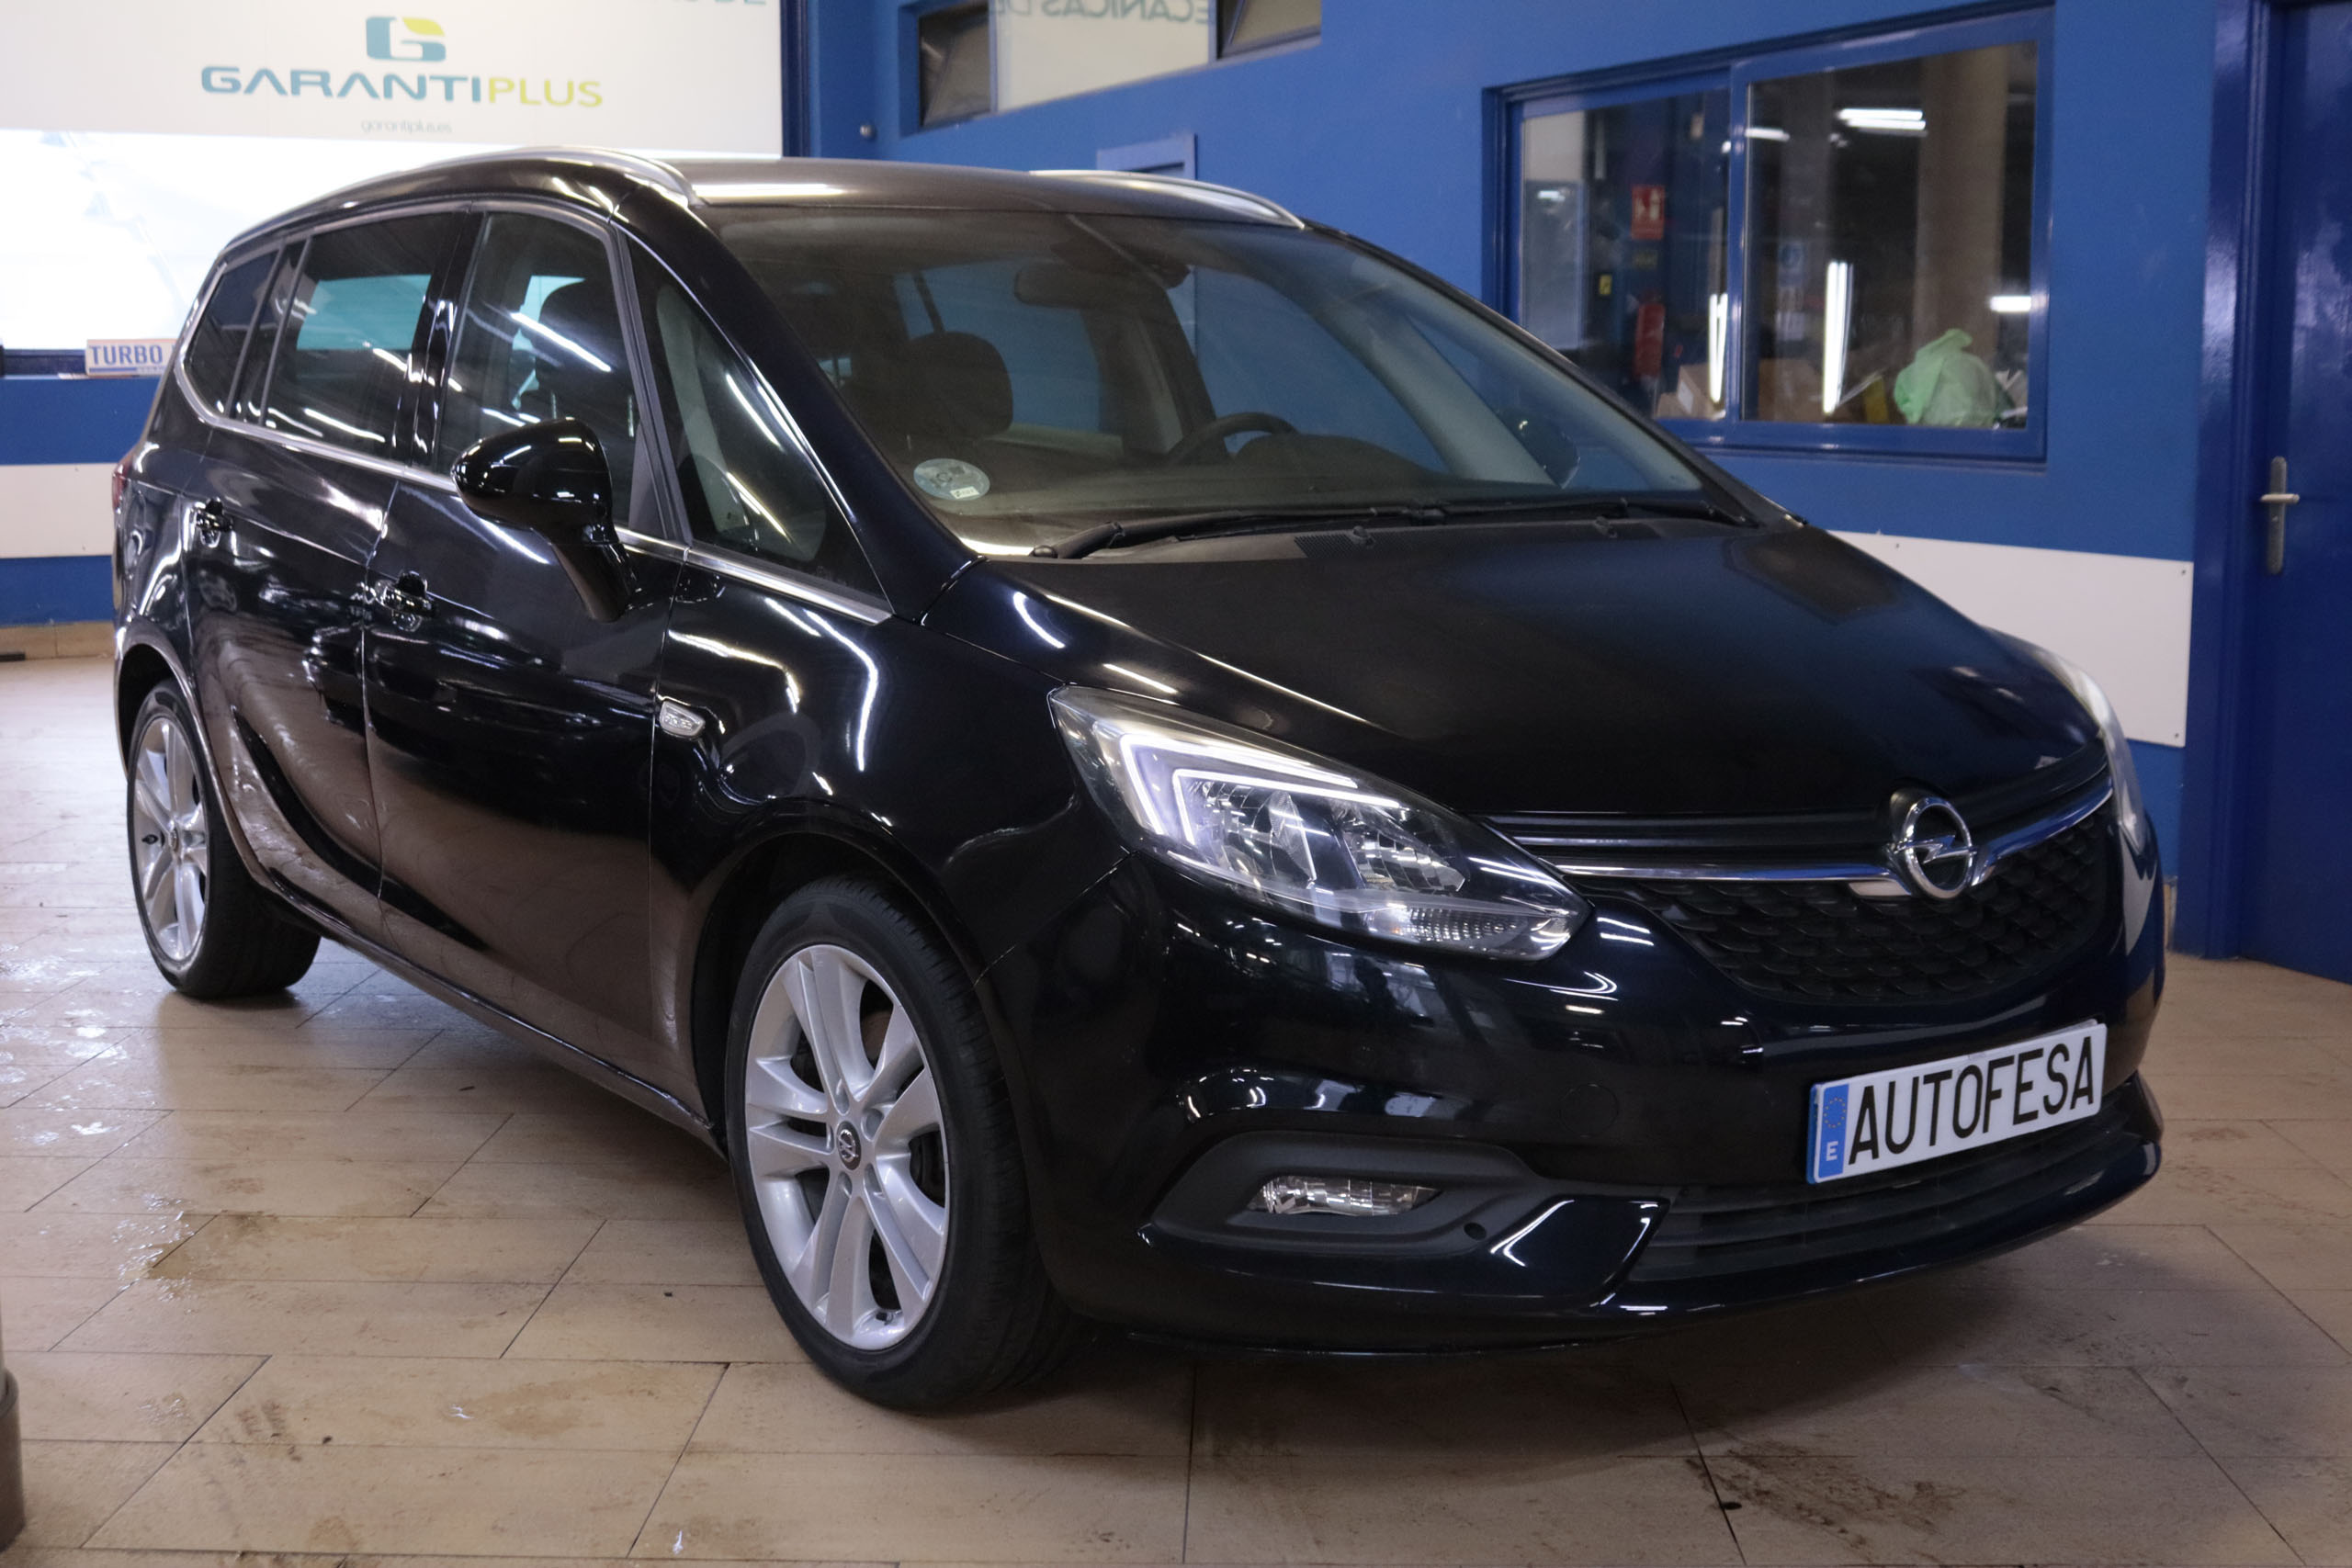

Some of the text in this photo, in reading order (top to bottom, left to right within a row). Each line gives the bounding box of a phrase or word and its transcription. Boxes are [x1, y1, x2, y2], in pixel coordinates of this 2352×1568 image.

[201, 66, 604, 107] GARANTIPLUS
[89, 344, 163, 365] TURBO
[1826, 1035, 2095, 1166] E AUTOFESA
